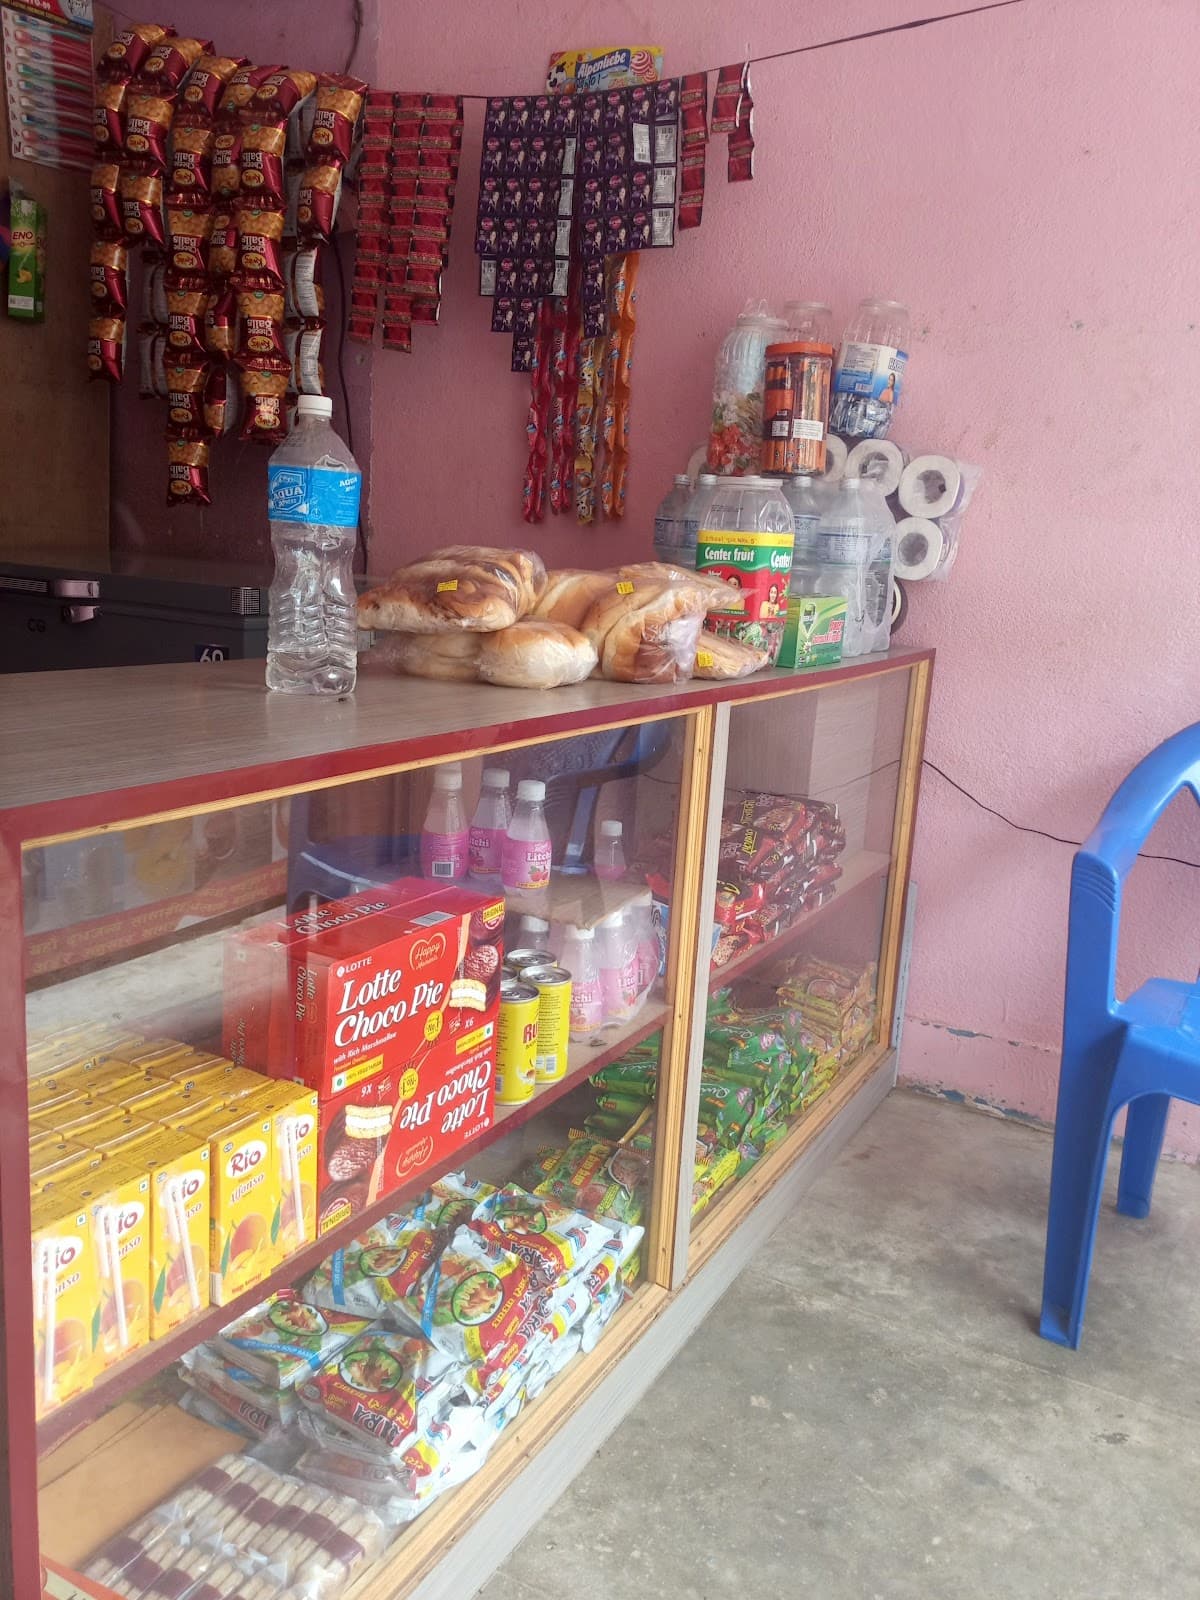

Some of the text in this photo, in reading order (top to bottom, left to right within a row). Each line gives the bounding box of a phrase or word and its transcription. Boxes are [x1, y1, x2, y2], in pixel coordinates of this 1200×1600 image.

[578, 51, 626, 80] Alpenliebe
[13, 231, 33, 240] ENO
[273, 486, 304, 501] AQUA
[704, 546, 755, 562] Center fruit
[296, 902, 390, 934] Choco Pie
[415, 941, 441, 960] Happy
[345, 956, 373, 974] LOTTE
[295, 966, 306, 1022] Choco Pie
[306, 969, 318, 1000] Lotte
[337, 968, 402, 1015] Lotte
[334, 978, 444, 1047] Choco Pie
[400, 1060, 492, 1131] Choco Pie
[441, 1087, 489, 1134] Lotte
[463, 1122, 485, 1139] LOTTE
[230, 1149, 261, 1176] Rio
[322, 1208, 350, 1229] ORIGINAL
